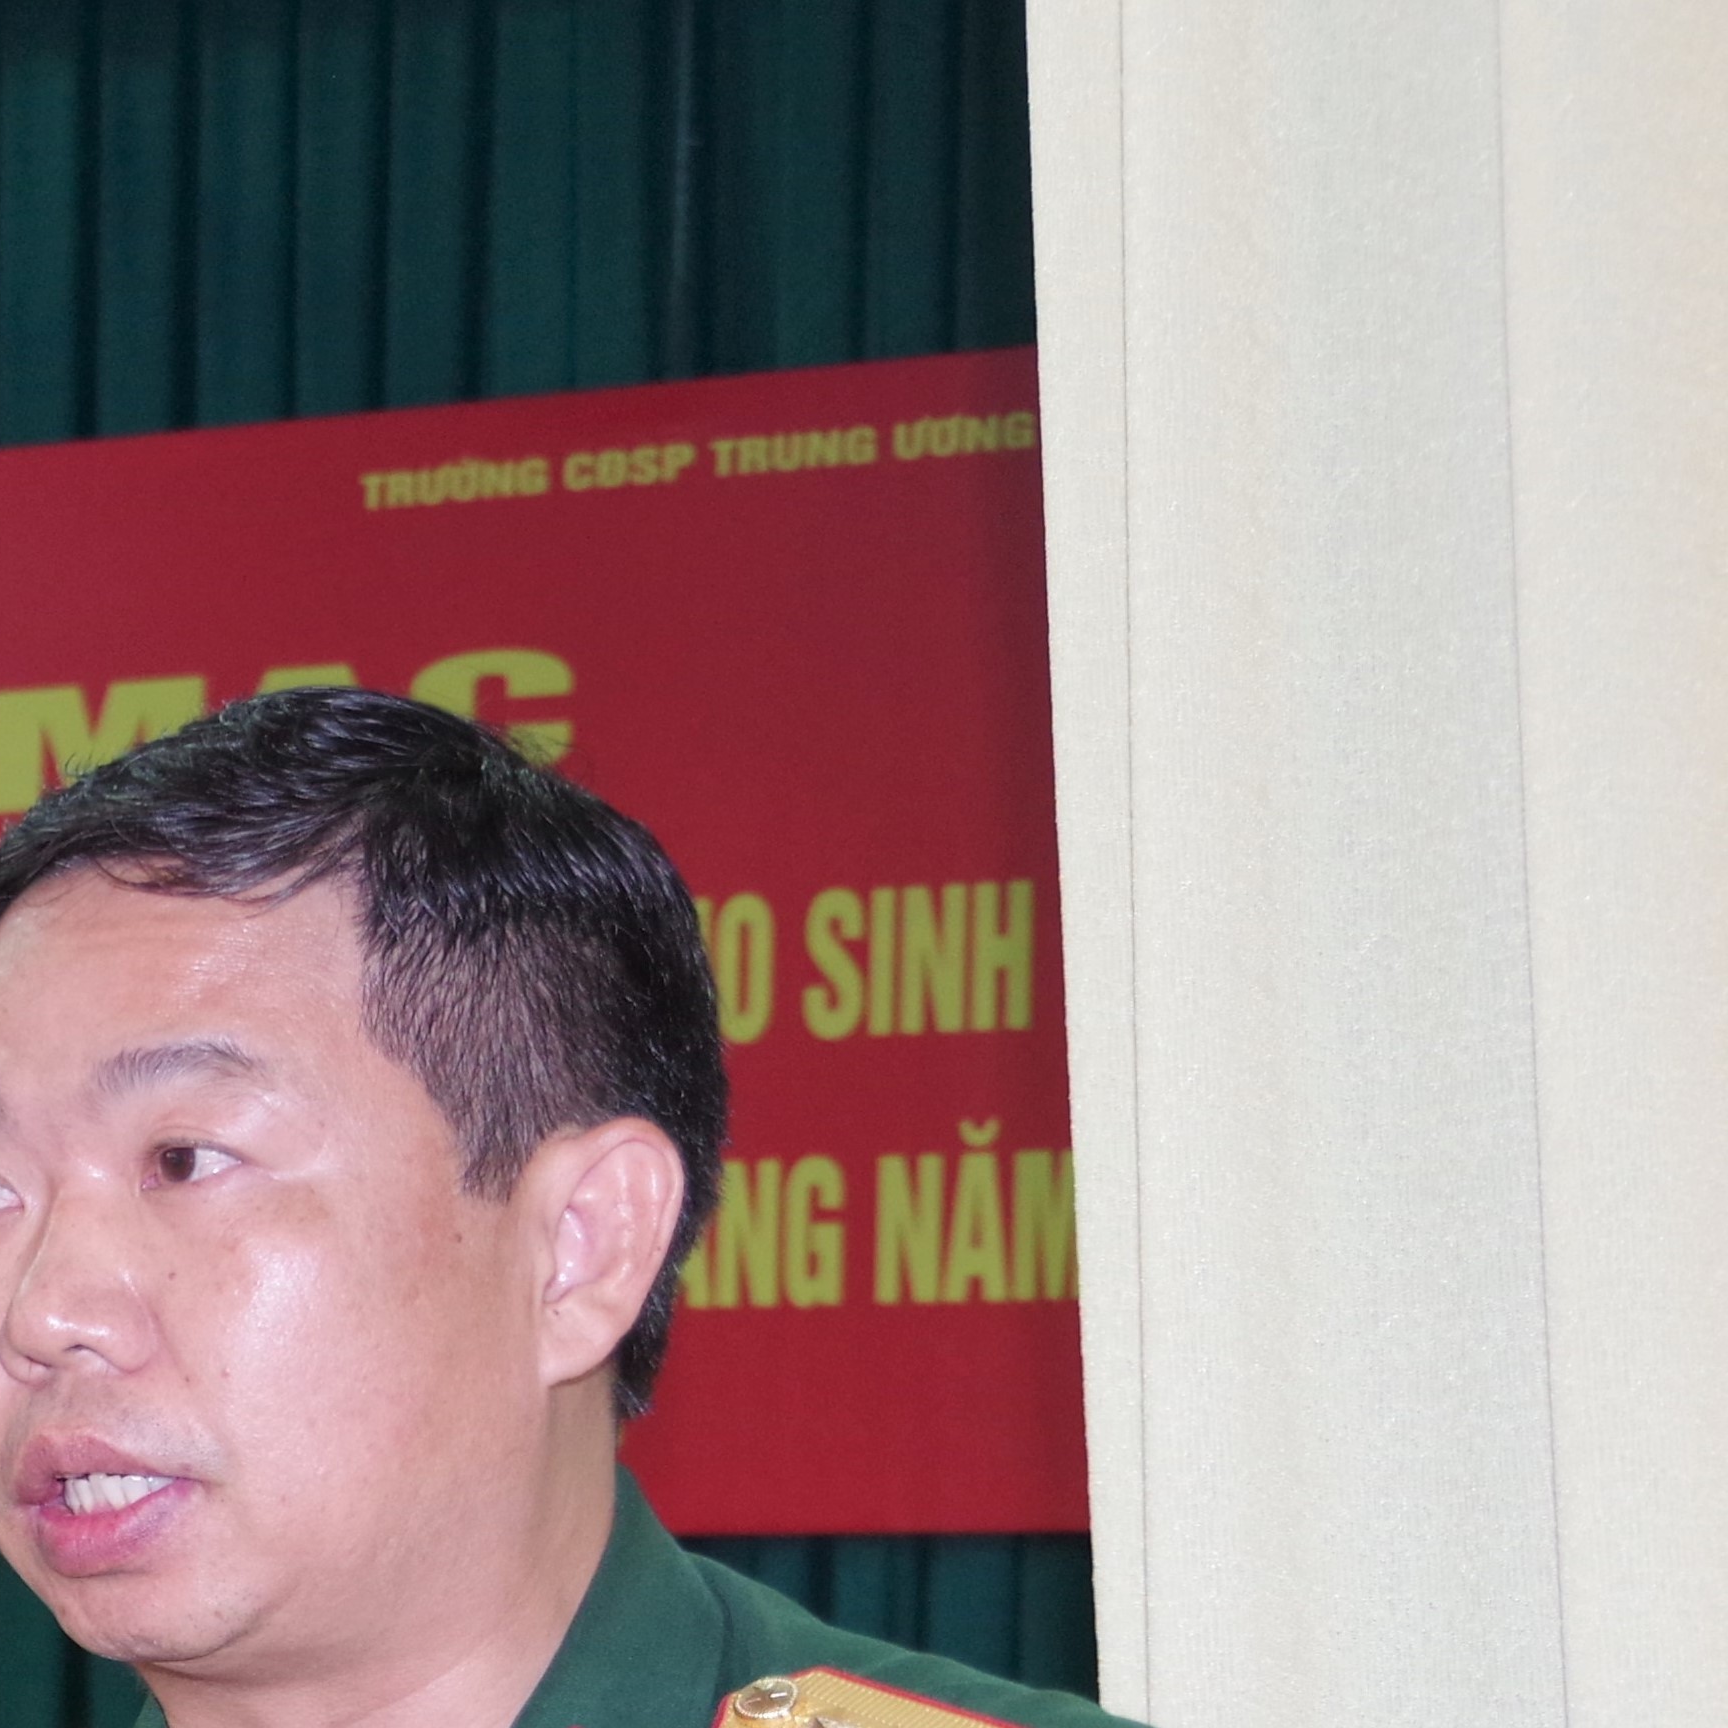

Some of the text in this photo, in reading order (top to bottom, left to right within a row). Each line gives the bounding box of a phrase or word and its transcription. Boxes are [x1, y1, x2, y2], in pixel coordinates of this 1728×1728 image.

[710, 426, 878, 476] TRUNG
[802, 878, 1035, 1041] SINH
[875, 1116, 1079, 1304] NĂM
